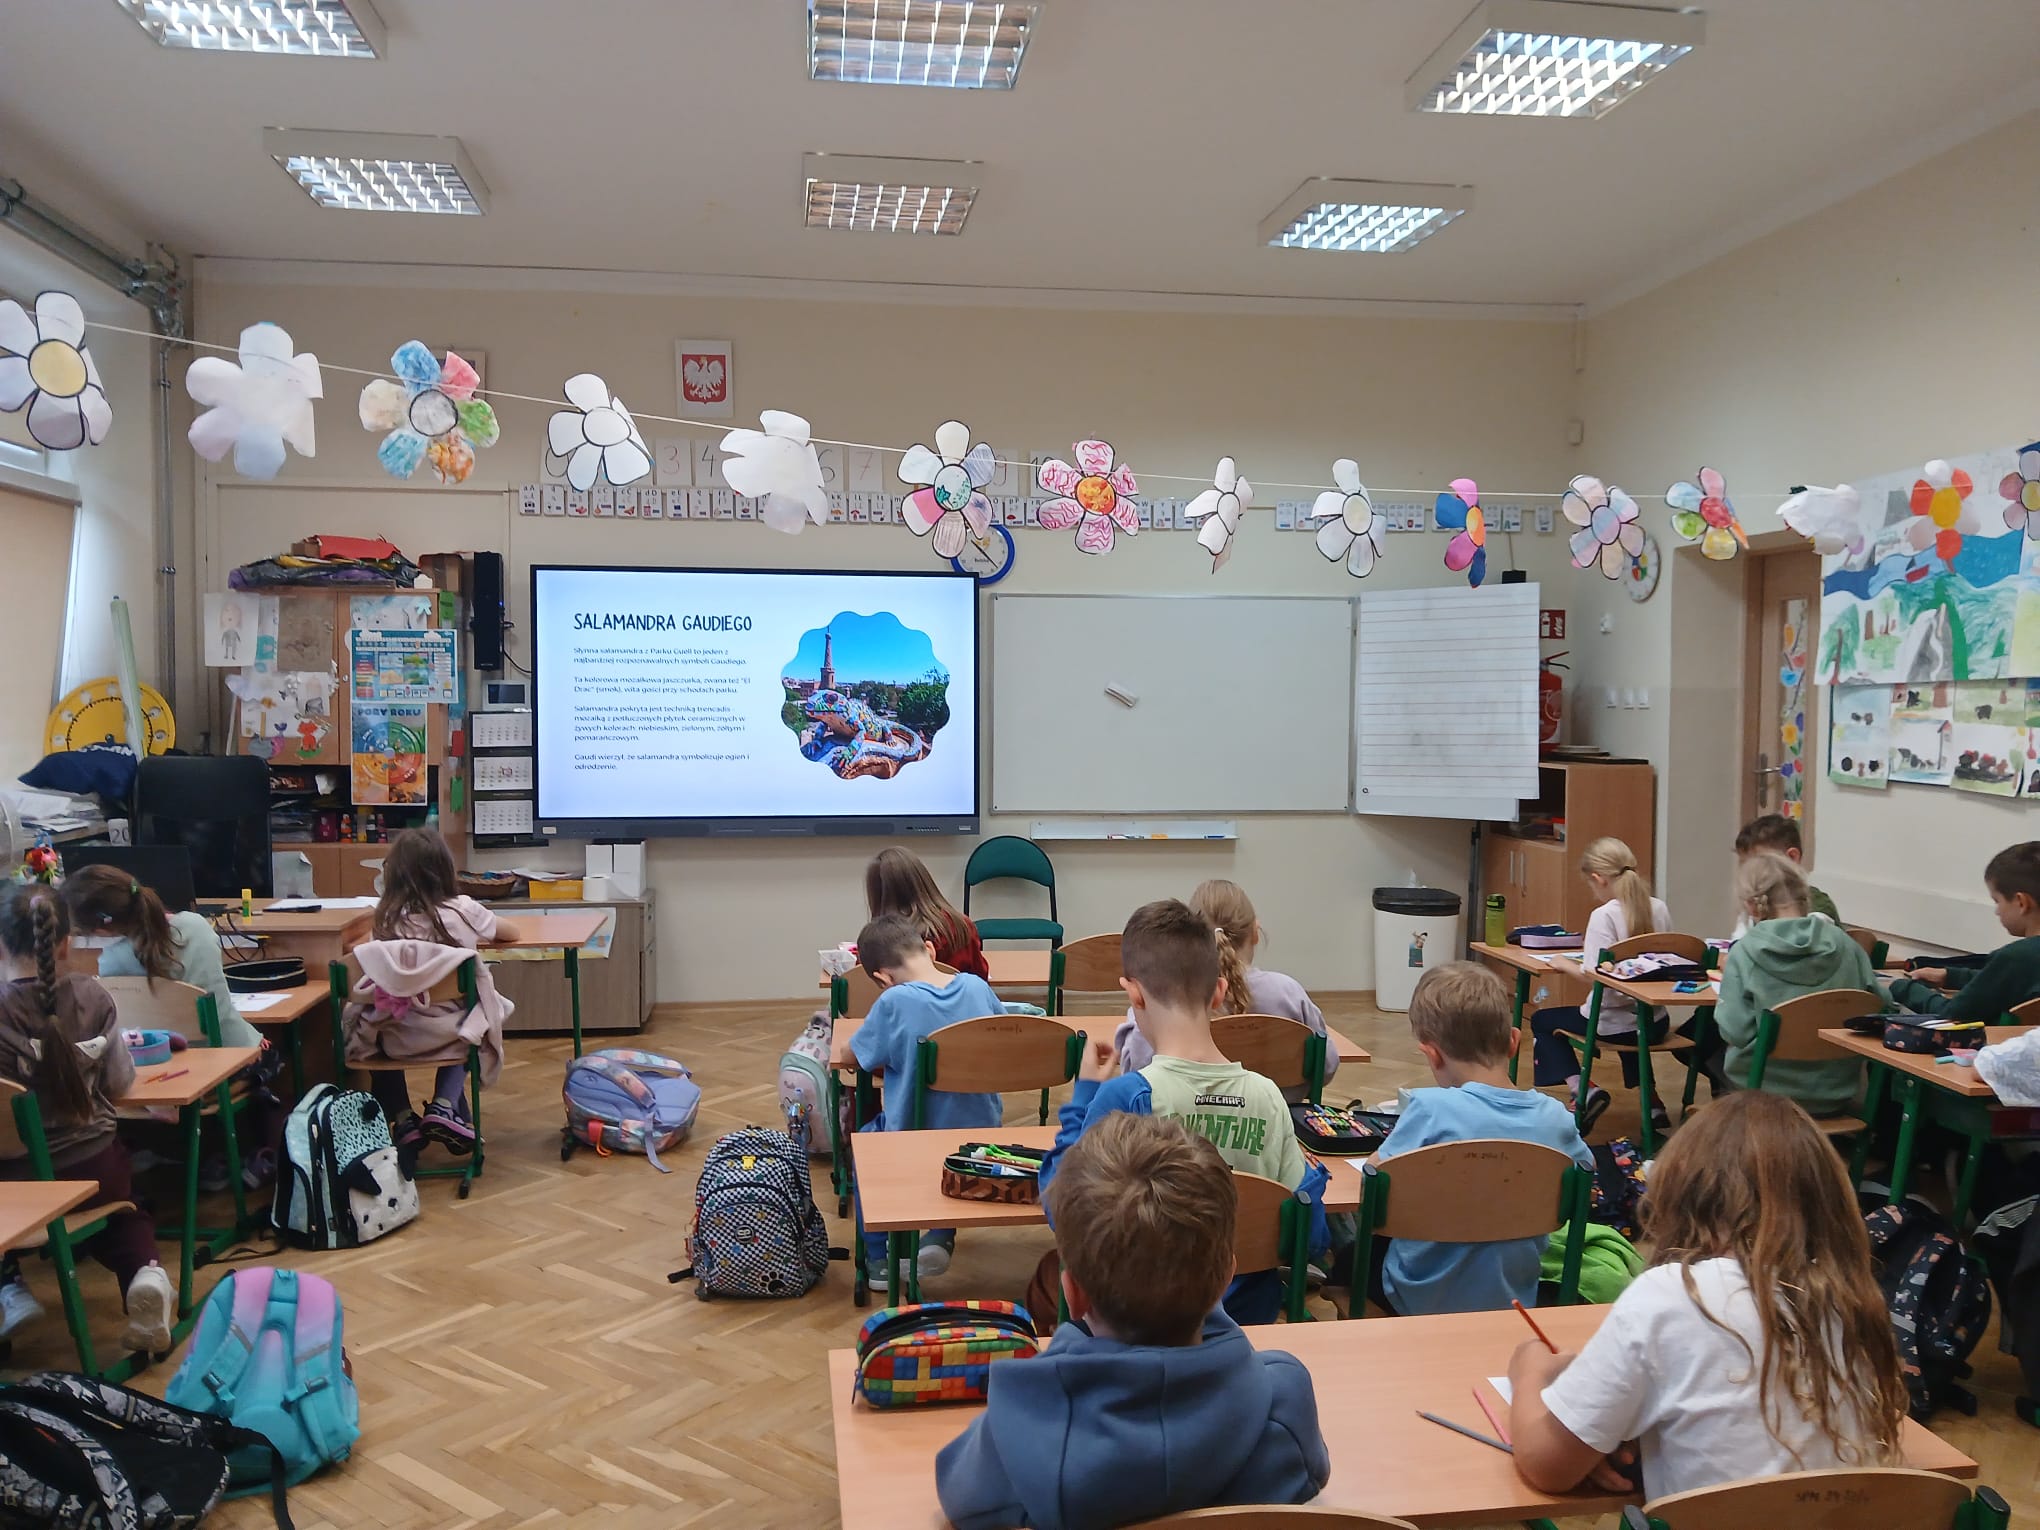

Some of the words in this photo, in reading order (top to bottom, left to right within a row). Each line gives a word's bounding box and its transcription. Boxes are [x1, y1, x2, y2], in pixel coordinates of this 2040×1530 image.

[662, 445, 679, 475] 3
[701, 445, 717, 478] 4
[817, 448, 836, 483] 6
[856, 451, 874, 480] 7
[573, 612, 677, 632] SALAMANDRA
[682, 614, 753, 632] GAUDIEGO
[600, 647, 643, 655] salamandra
[650, 647, 672, 655] Parku
[573, 657, 615, 665] najbardziej
[615, 657, 680, 665] rozpoznawalnych
[681, 657, 710, 665] symboli
[584, 676, 618, 684] kolorowa
[619, 676, 662, 684] mozaikowa
[624, 686, 640, 694] wita
[679, 686, 715, 695] schodach
[390, 708, 422, 717] ROKU
[574, 705, 619, 713] Salamandra
[619, 705, 648, 714] pokryta
[649, 705, 663, 714] jest
[687, 715, 738, 723] ceramicznych
[636, 753, 680, 761] salamandra
[681, 754, 724, 762] symbolizuje
[1195, 1094, 1246, 1108] MINECRAFT
[1160, 1112, 1267, 1156] VENTURE
